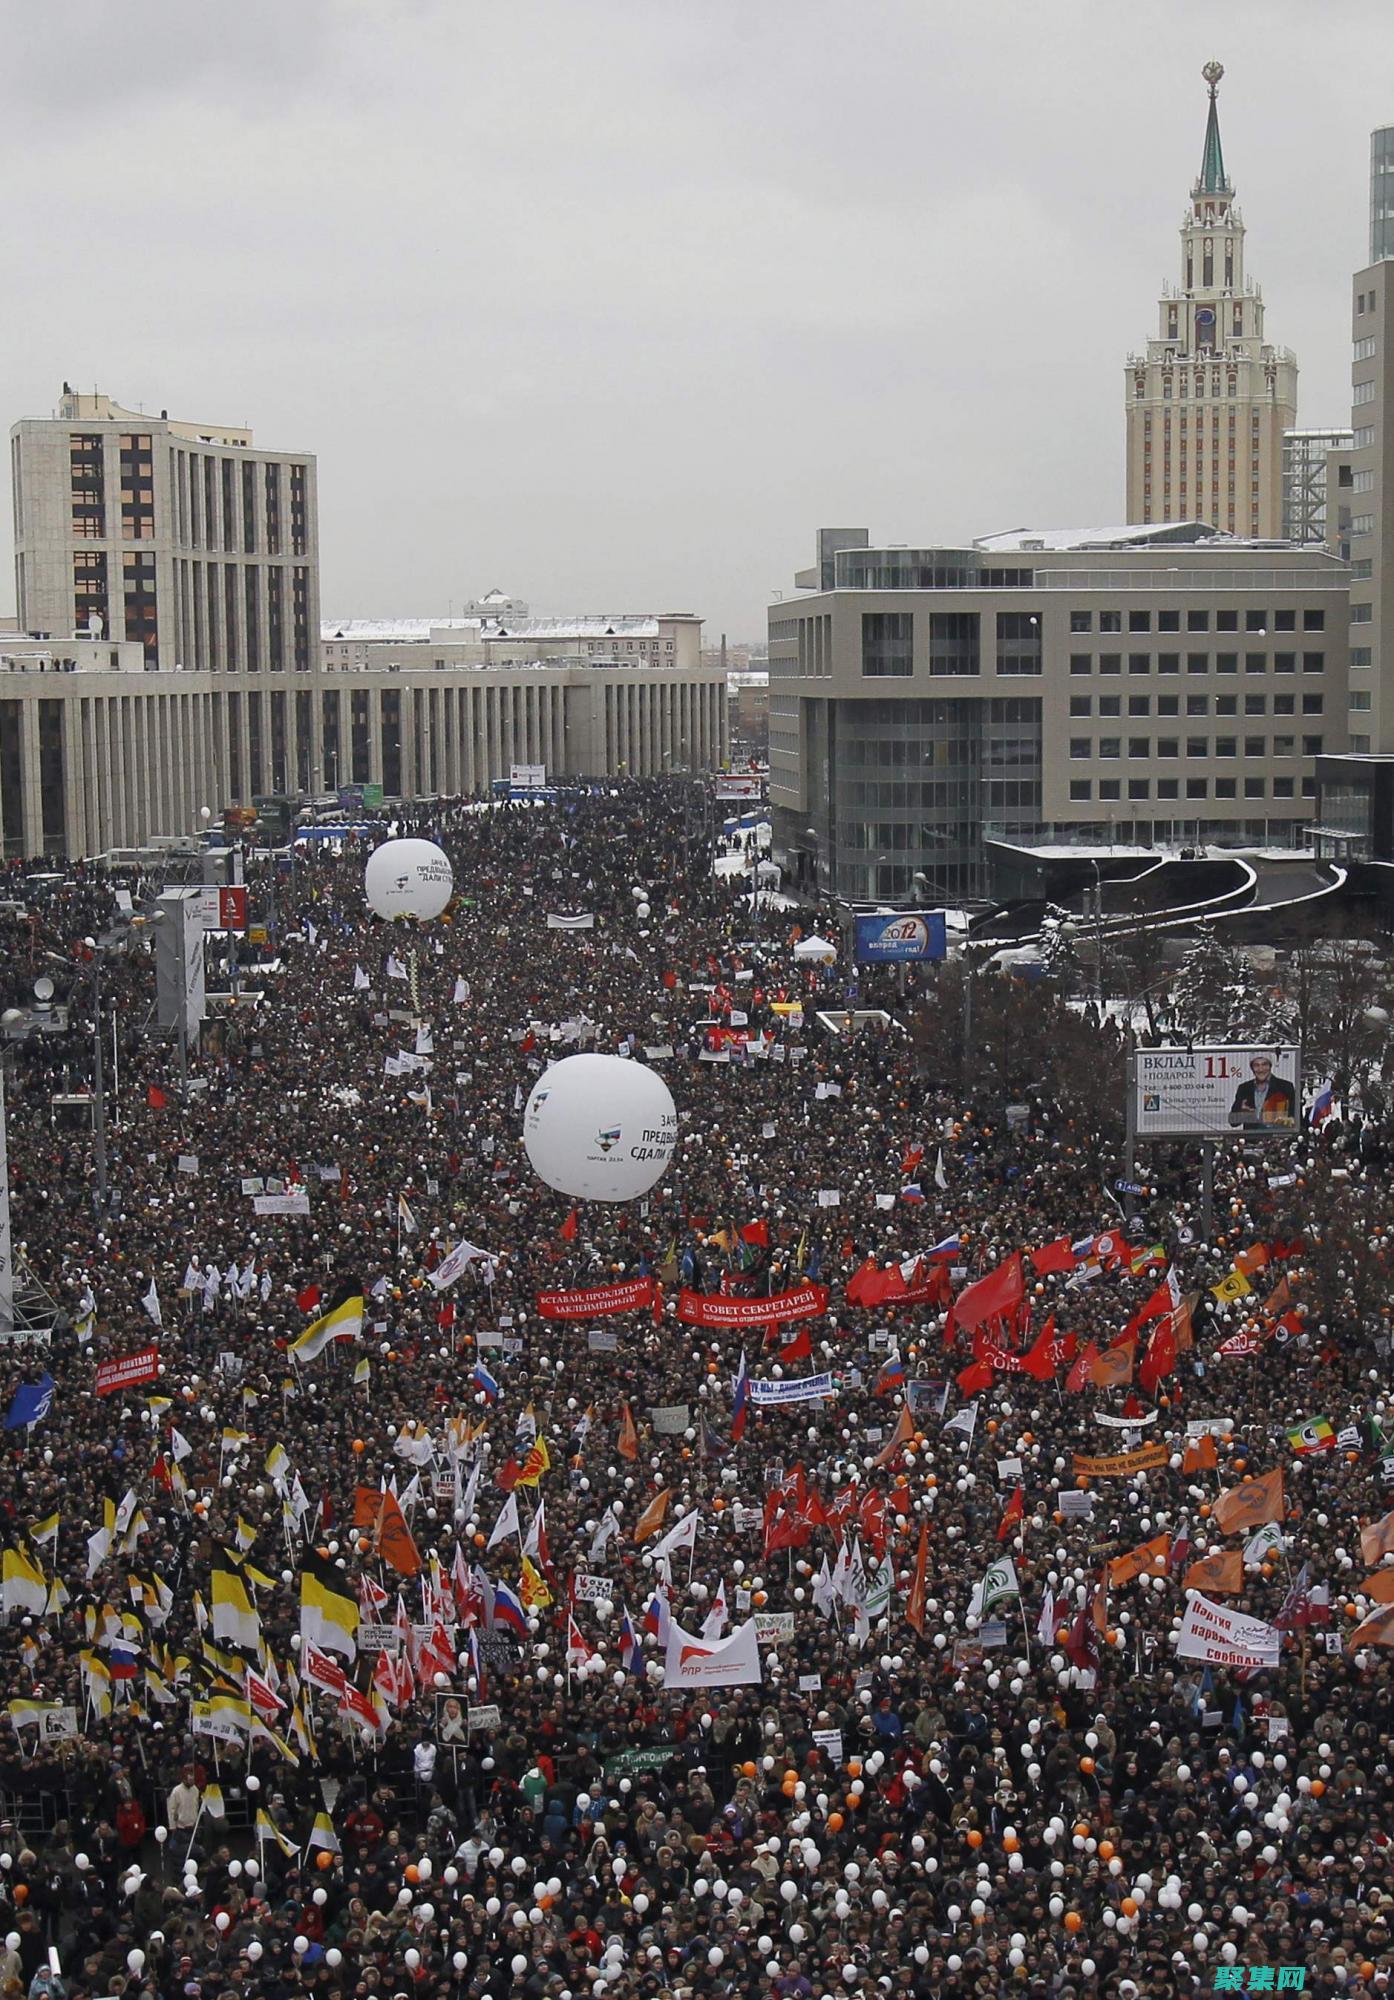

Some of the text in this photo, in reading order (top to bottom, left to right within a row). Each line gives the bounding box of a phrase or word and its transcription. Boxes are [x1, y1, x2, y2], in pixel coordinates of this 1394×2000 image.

[1144, 1056, 1243, 1079] ВКЛАД 11%
[1144, 1071, 1196, 1081] +ПОДАРОК
[630, 1146, 666, 1162] СДАЛИ
[586, 1280, 649, 1302] ПРОКЛЯТЬЕМ
[702, 1289, 816, 1316] СОВЕТ СЕКРЕТАРЕЙ
[1191, 1600, 1232, 1631] Партия
[681, 1666, 702, 1676] РПР
